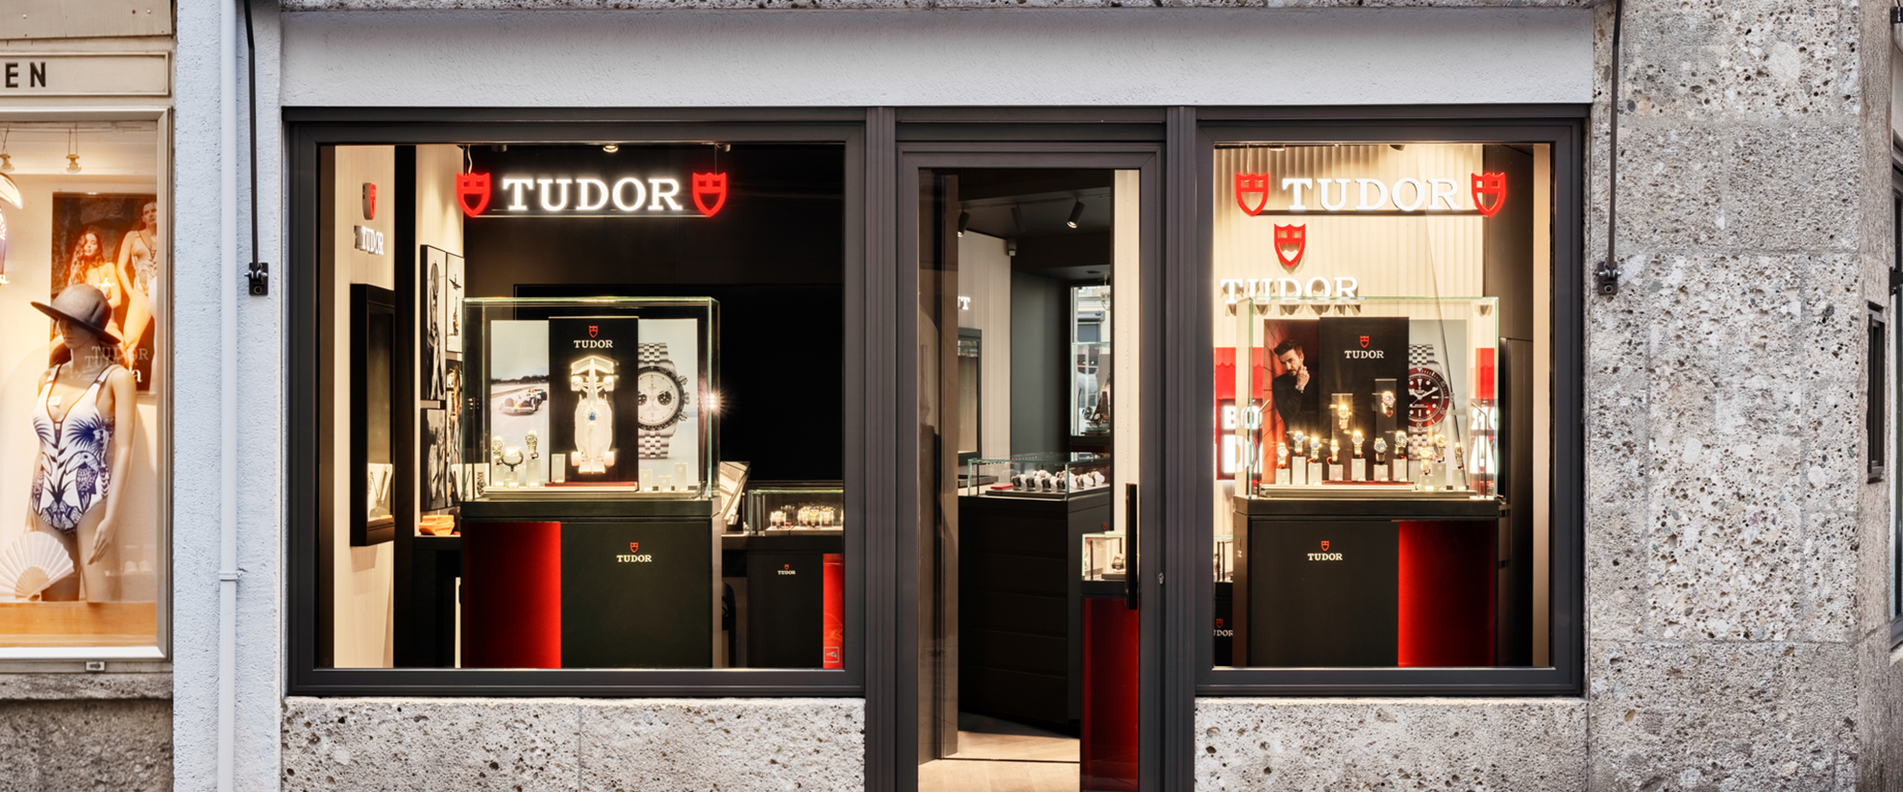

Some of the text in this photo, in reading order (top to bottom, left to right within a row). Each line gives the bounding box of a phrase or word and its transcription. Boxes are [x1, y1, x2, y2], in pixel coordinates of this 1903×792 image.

[502, 177, 683, 211] TUDOR
[1281, 177, 1462, 212] TUDOR
[361, 225, 384, 255] TUDOR
[1220, 276, 1360, 305] TUDOR
[573, 339, 614, 349] TUDOR
[1344, 350, 1384, 359] TUDOR
[616, 554, 652, 563] TUDOR
[1307, 552, 1343, 561] TUDOR
